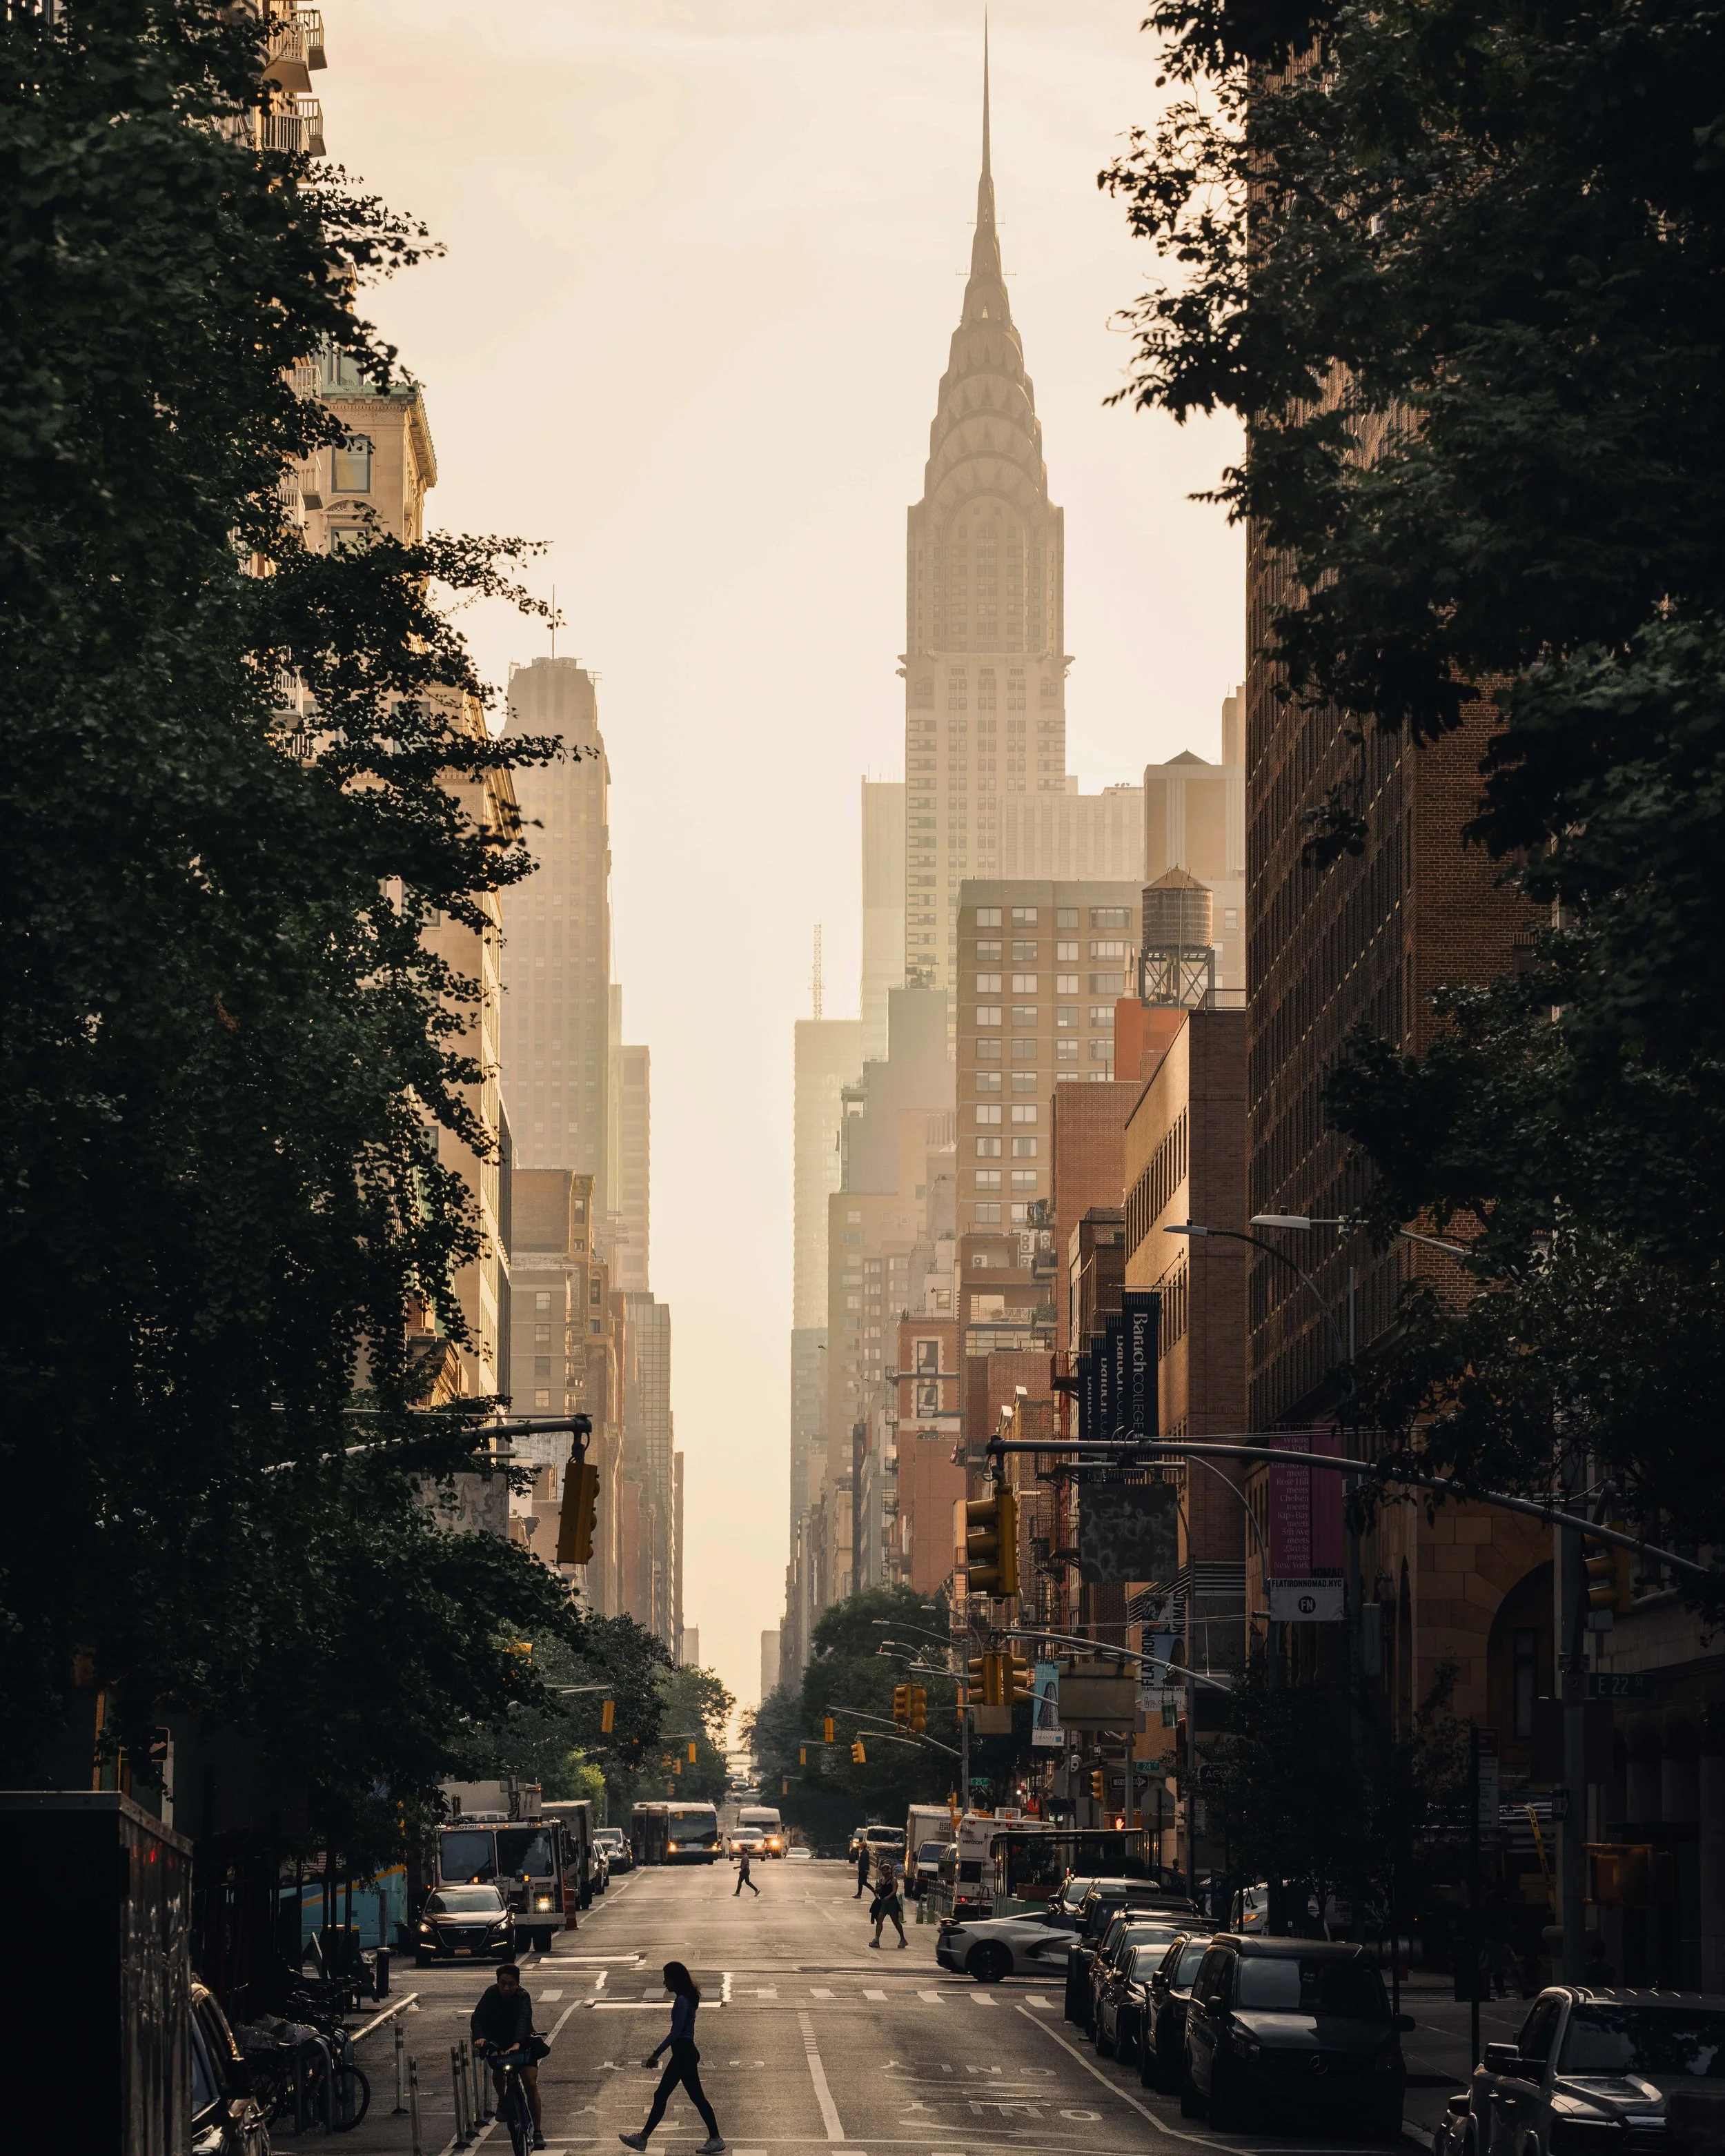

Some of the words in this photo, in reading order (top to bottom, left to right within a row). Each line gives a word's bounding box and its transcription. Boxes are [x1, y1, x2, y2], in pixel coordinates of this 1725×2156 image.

[1133, 1313, 1148, 1372] Baruch
[1133, 1373, 1144, 1428] COLLEGE
[1277, 1512, 1294, 1520] Kips
[1296, 1512, 1309, 1520] Bay
[1311, 1567, 1343, 1579] NOMAD
[1272, 1579, 1342, 1588] FLATIRONNOMAD.NYC
[1301, 1599, 1314, 1611] FN
[1172, 1594, 1186, 1635] NOMAD
[1141, 1634, 1154, 1686] FLATRON
[1598, 1677, 1606, 1694] E
[1612, 1677, 1629, 1694] 22
